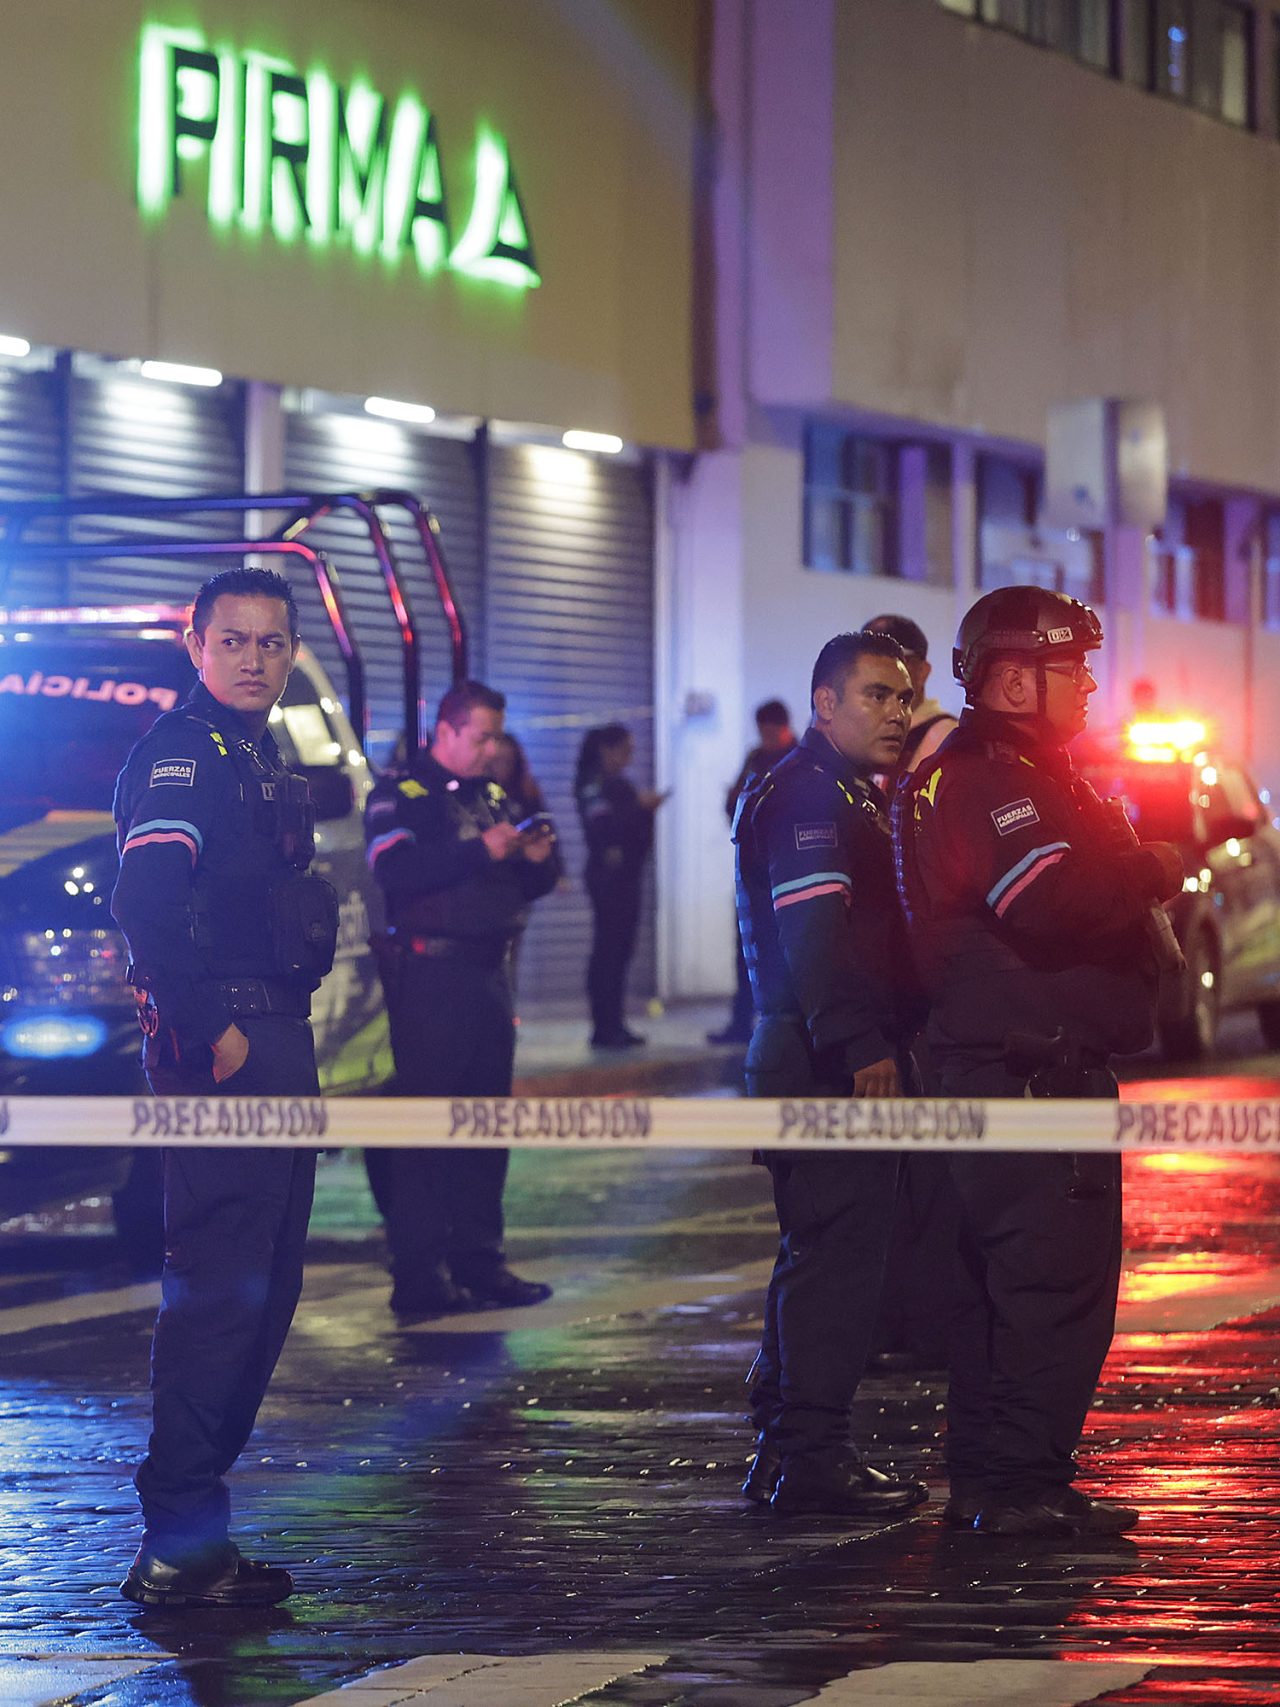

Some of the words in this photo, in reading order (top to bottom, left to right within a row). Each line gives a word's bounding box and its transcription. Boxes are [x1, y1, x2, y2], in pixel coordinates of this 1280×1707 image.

[136, 22, 450, 276] PIRMA
[154, 766, 192, 775] FUERZAS
[997, 805, 1032, 823] FUERZAS
[131, 1099, 328, 1137] PRECAUCION
[449, 1100, 652, 1138] PRECAUCION
[777, 1101, 988, 1140] PRECAUCION
[1114, 1104, 1280, 1144] PRECAUC
